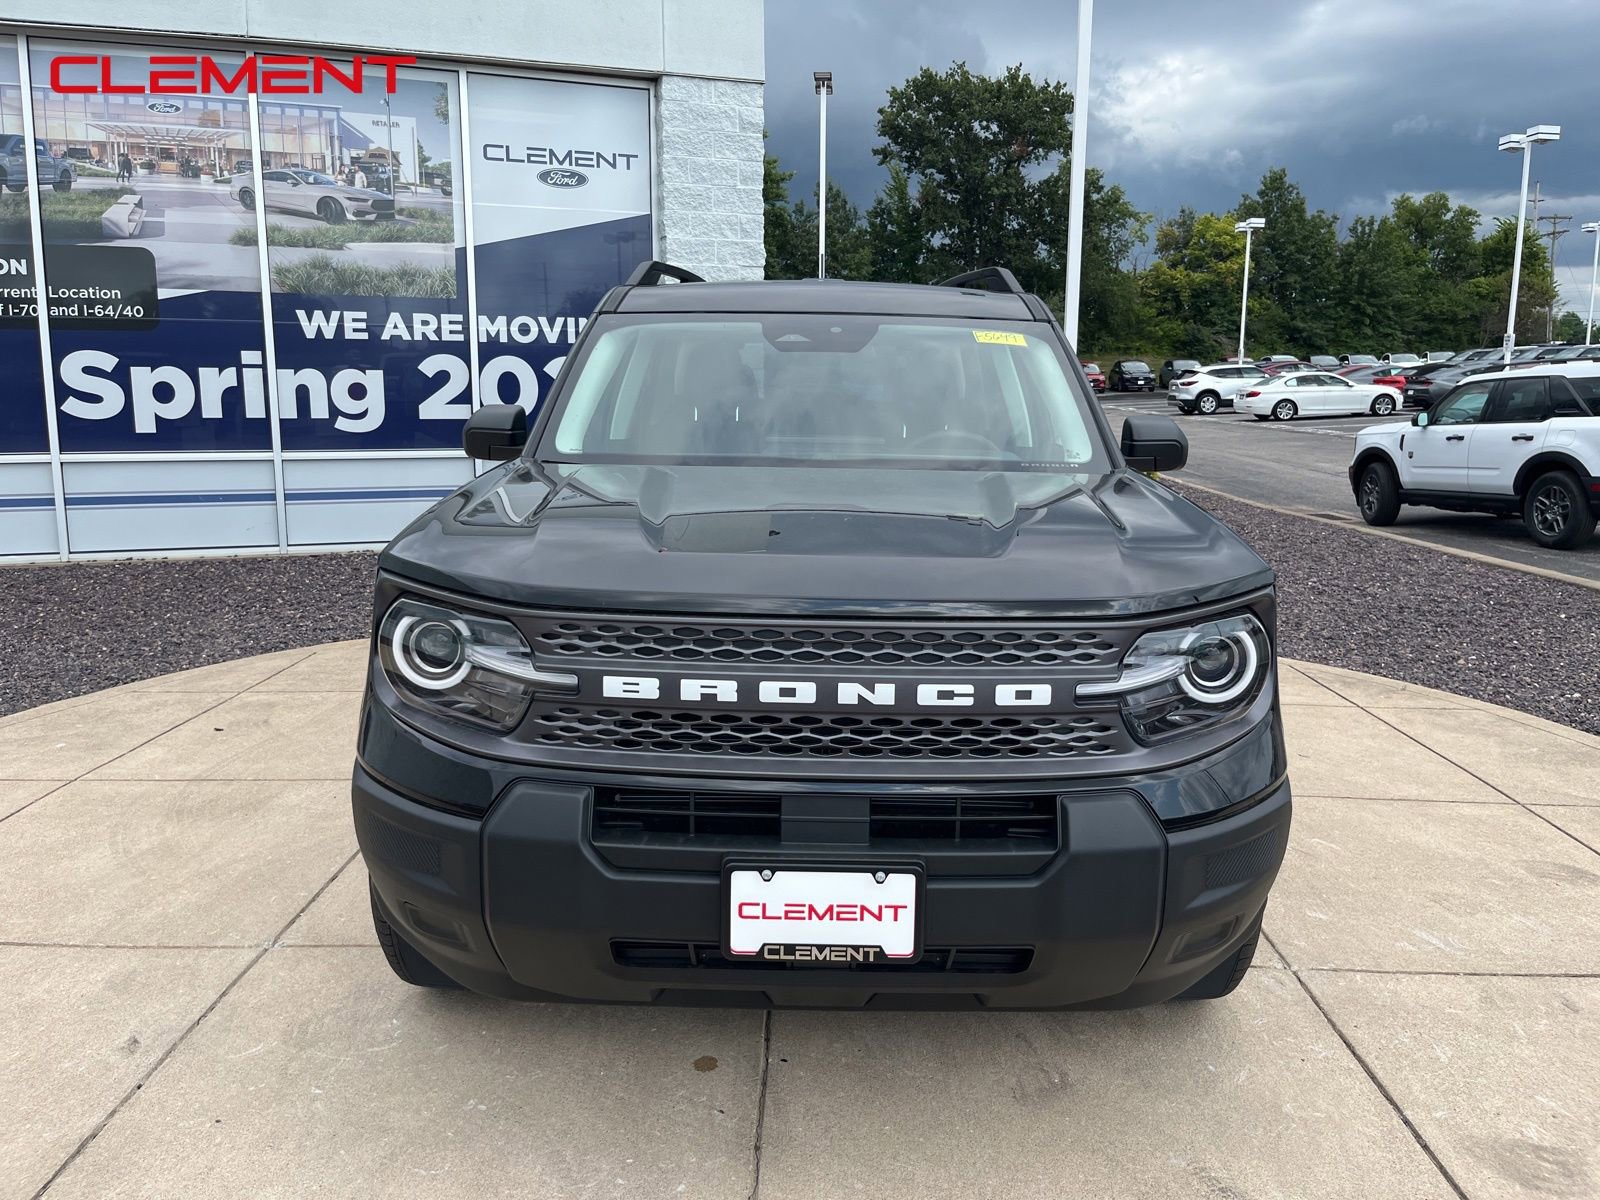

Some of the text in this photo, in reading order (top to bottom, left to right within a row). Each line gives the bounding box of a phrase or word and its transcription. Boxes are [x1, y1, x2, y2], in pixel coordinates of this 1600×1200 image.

[372, 120, 401, 128] RETALER
[483, 143, 639, 170] CLEMENT
[546, 170, 579, 187] Ford
[49, 285, 121, 299] Location
[9, 303, 39, 317] I-70
[50, 304, 78, 317] and
[84, 304, 144, 319] I-64/40
[296, 309, 369, 340] WE
[380, 311, 465, 342] ARE
[60, 349, 568, 434] Spring 20
[602, 675, 1052, 706] BRONCO
[737, 902, 908, 922] CLEMENT
[763, 944, 880, 962] CLEMENT
